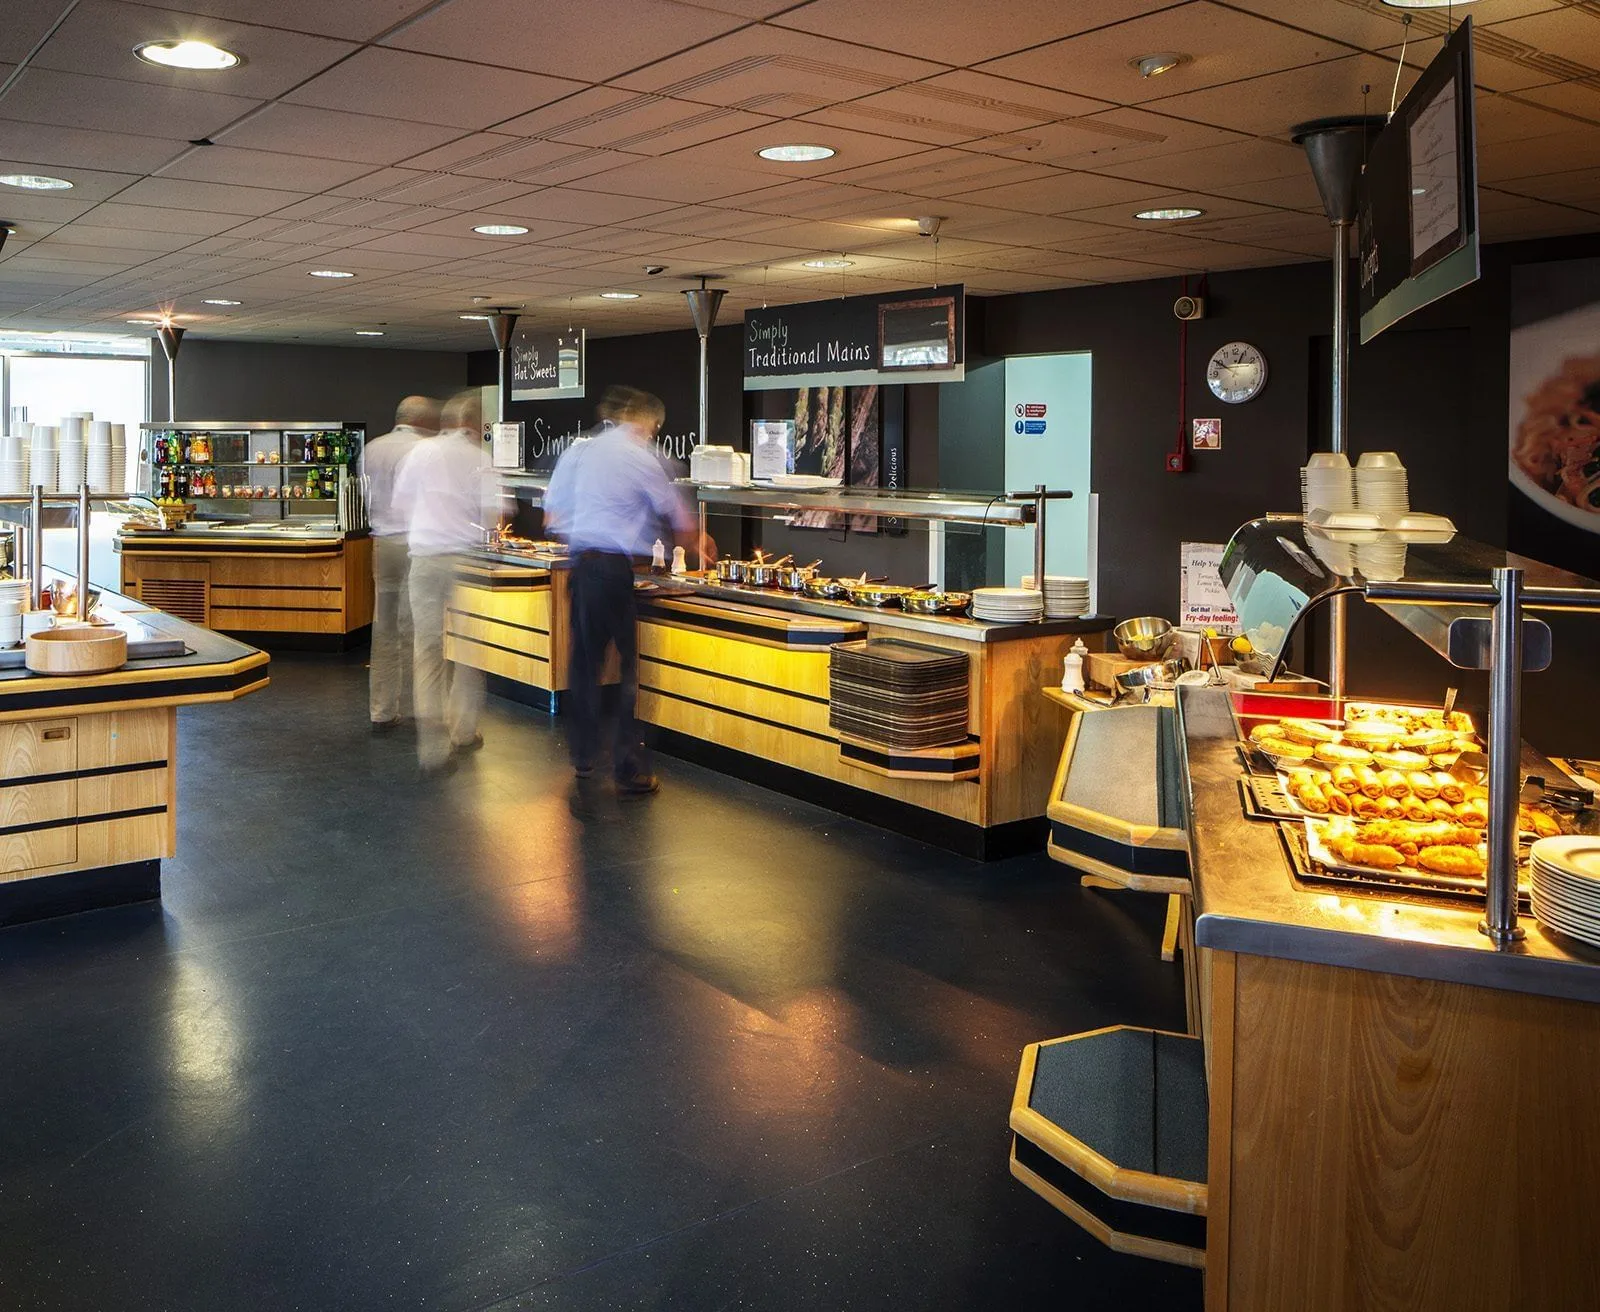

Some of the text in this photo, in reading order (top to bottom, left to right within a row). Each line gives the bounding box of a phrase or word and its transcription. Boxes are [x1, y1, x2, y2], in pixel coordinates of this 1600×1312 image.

[750, 318, 788, 348] Simply
[515, 345, 538, 369] Simply
[748, 340, 870, 368] Traditional Mains
[514, 362, 557, 380] Hot Sweets
[533, 417, 592, 458] Siml
[888, 447, 897, 490] Delicious
[1191, 560, 1207, 568] Help
[1186, 614, 1239, 623] Fry-day feeling!
